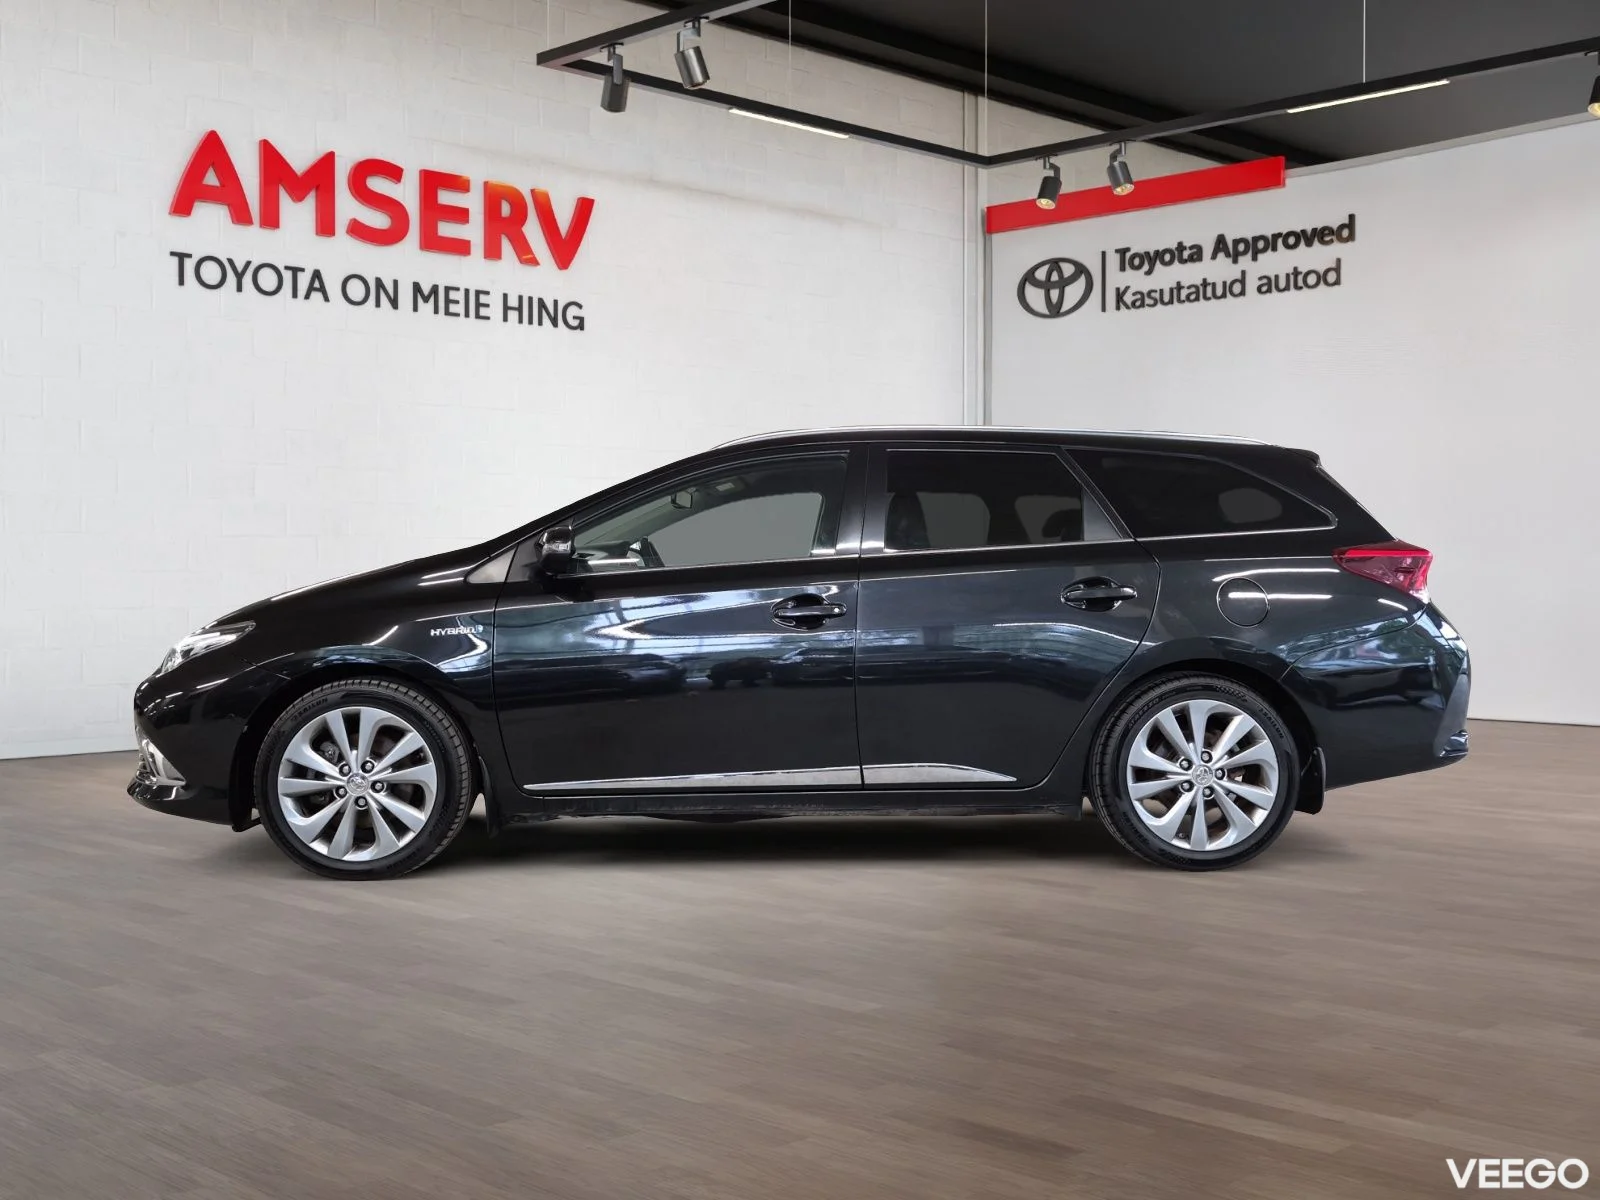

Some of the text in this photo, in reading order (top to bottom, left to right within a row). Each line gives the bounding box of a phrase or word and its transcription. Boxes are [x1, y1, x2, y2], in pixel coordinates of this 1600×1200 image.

[168, 129, 595, 271] AMSERV
[1114, 213, 1356, 275] Toyota Approved
[170, 251, 586, 331] TOYOTA ON MEIE HING
[1114, 257, 1342, 311] Kasutatud autod
